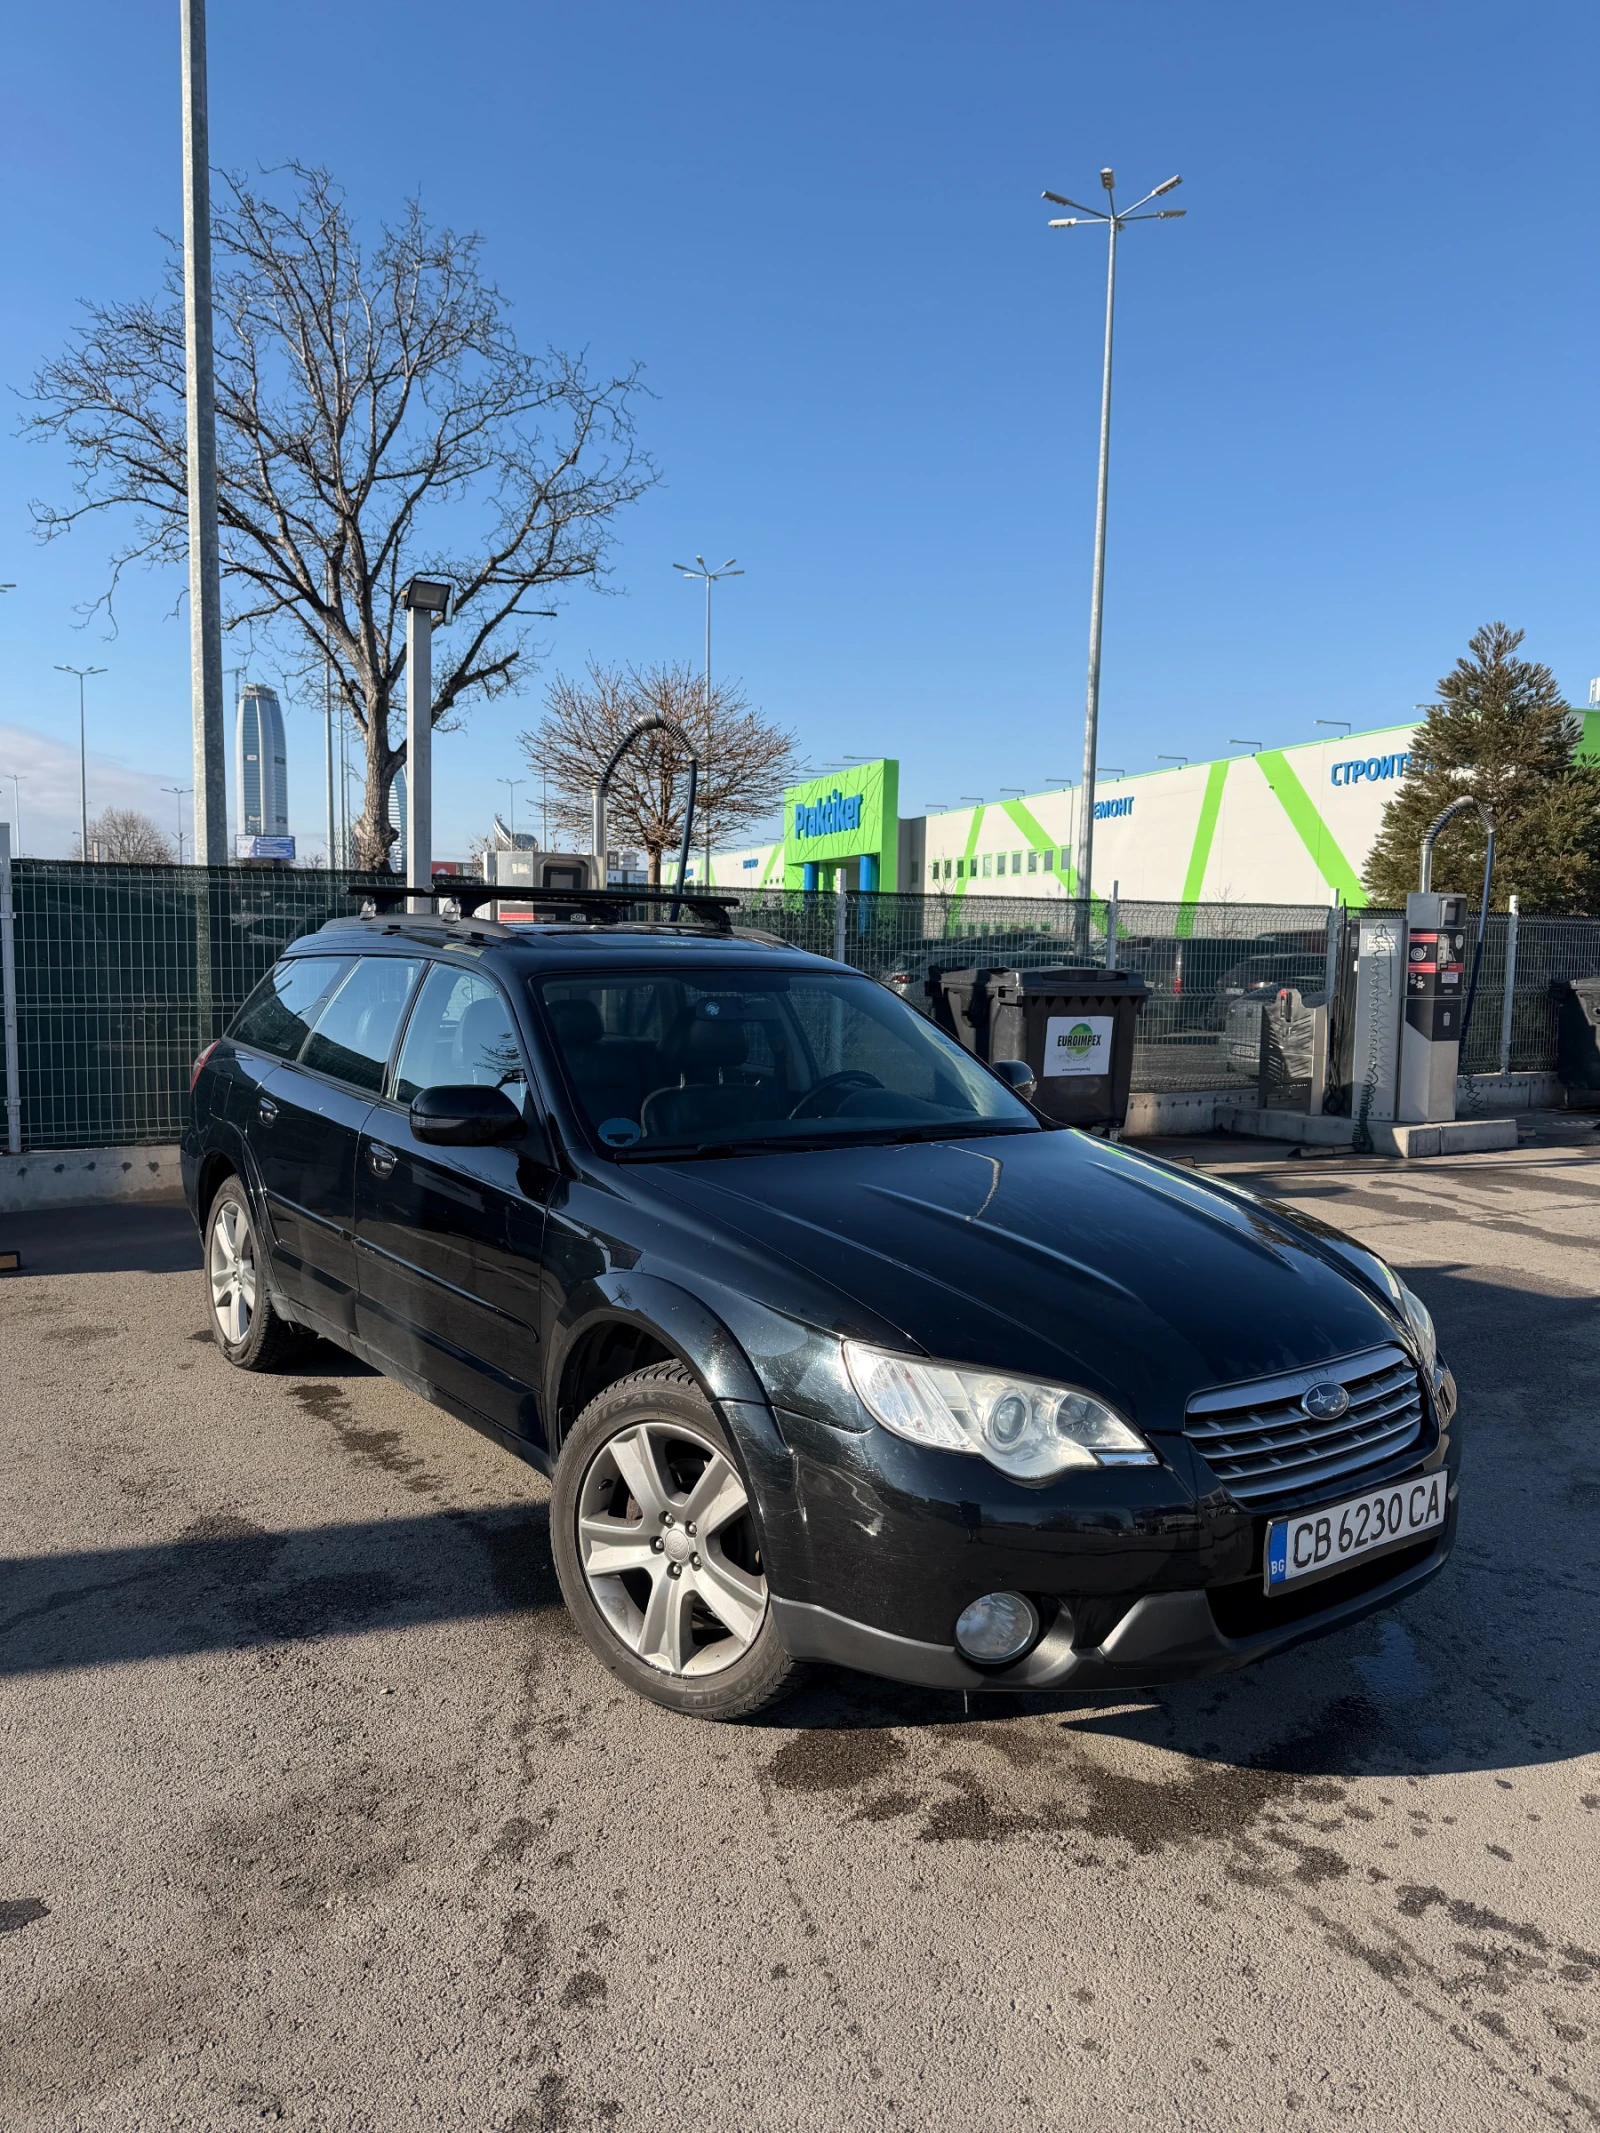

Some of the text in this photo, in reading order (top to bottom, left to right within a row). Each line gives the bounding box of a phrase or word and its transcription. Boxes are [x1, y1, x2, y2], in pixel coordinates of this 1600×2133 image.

[795, 788, 863, 840] Praktiker
[1094, 796, 1134, 820] ЕМОНТ
[1057, 1034, 1102, 1047] EUROIMPEX
[1293, 1480, 1440, 1568] CB 6230 CA
[1271, 1559, 1285, 1575] BG
